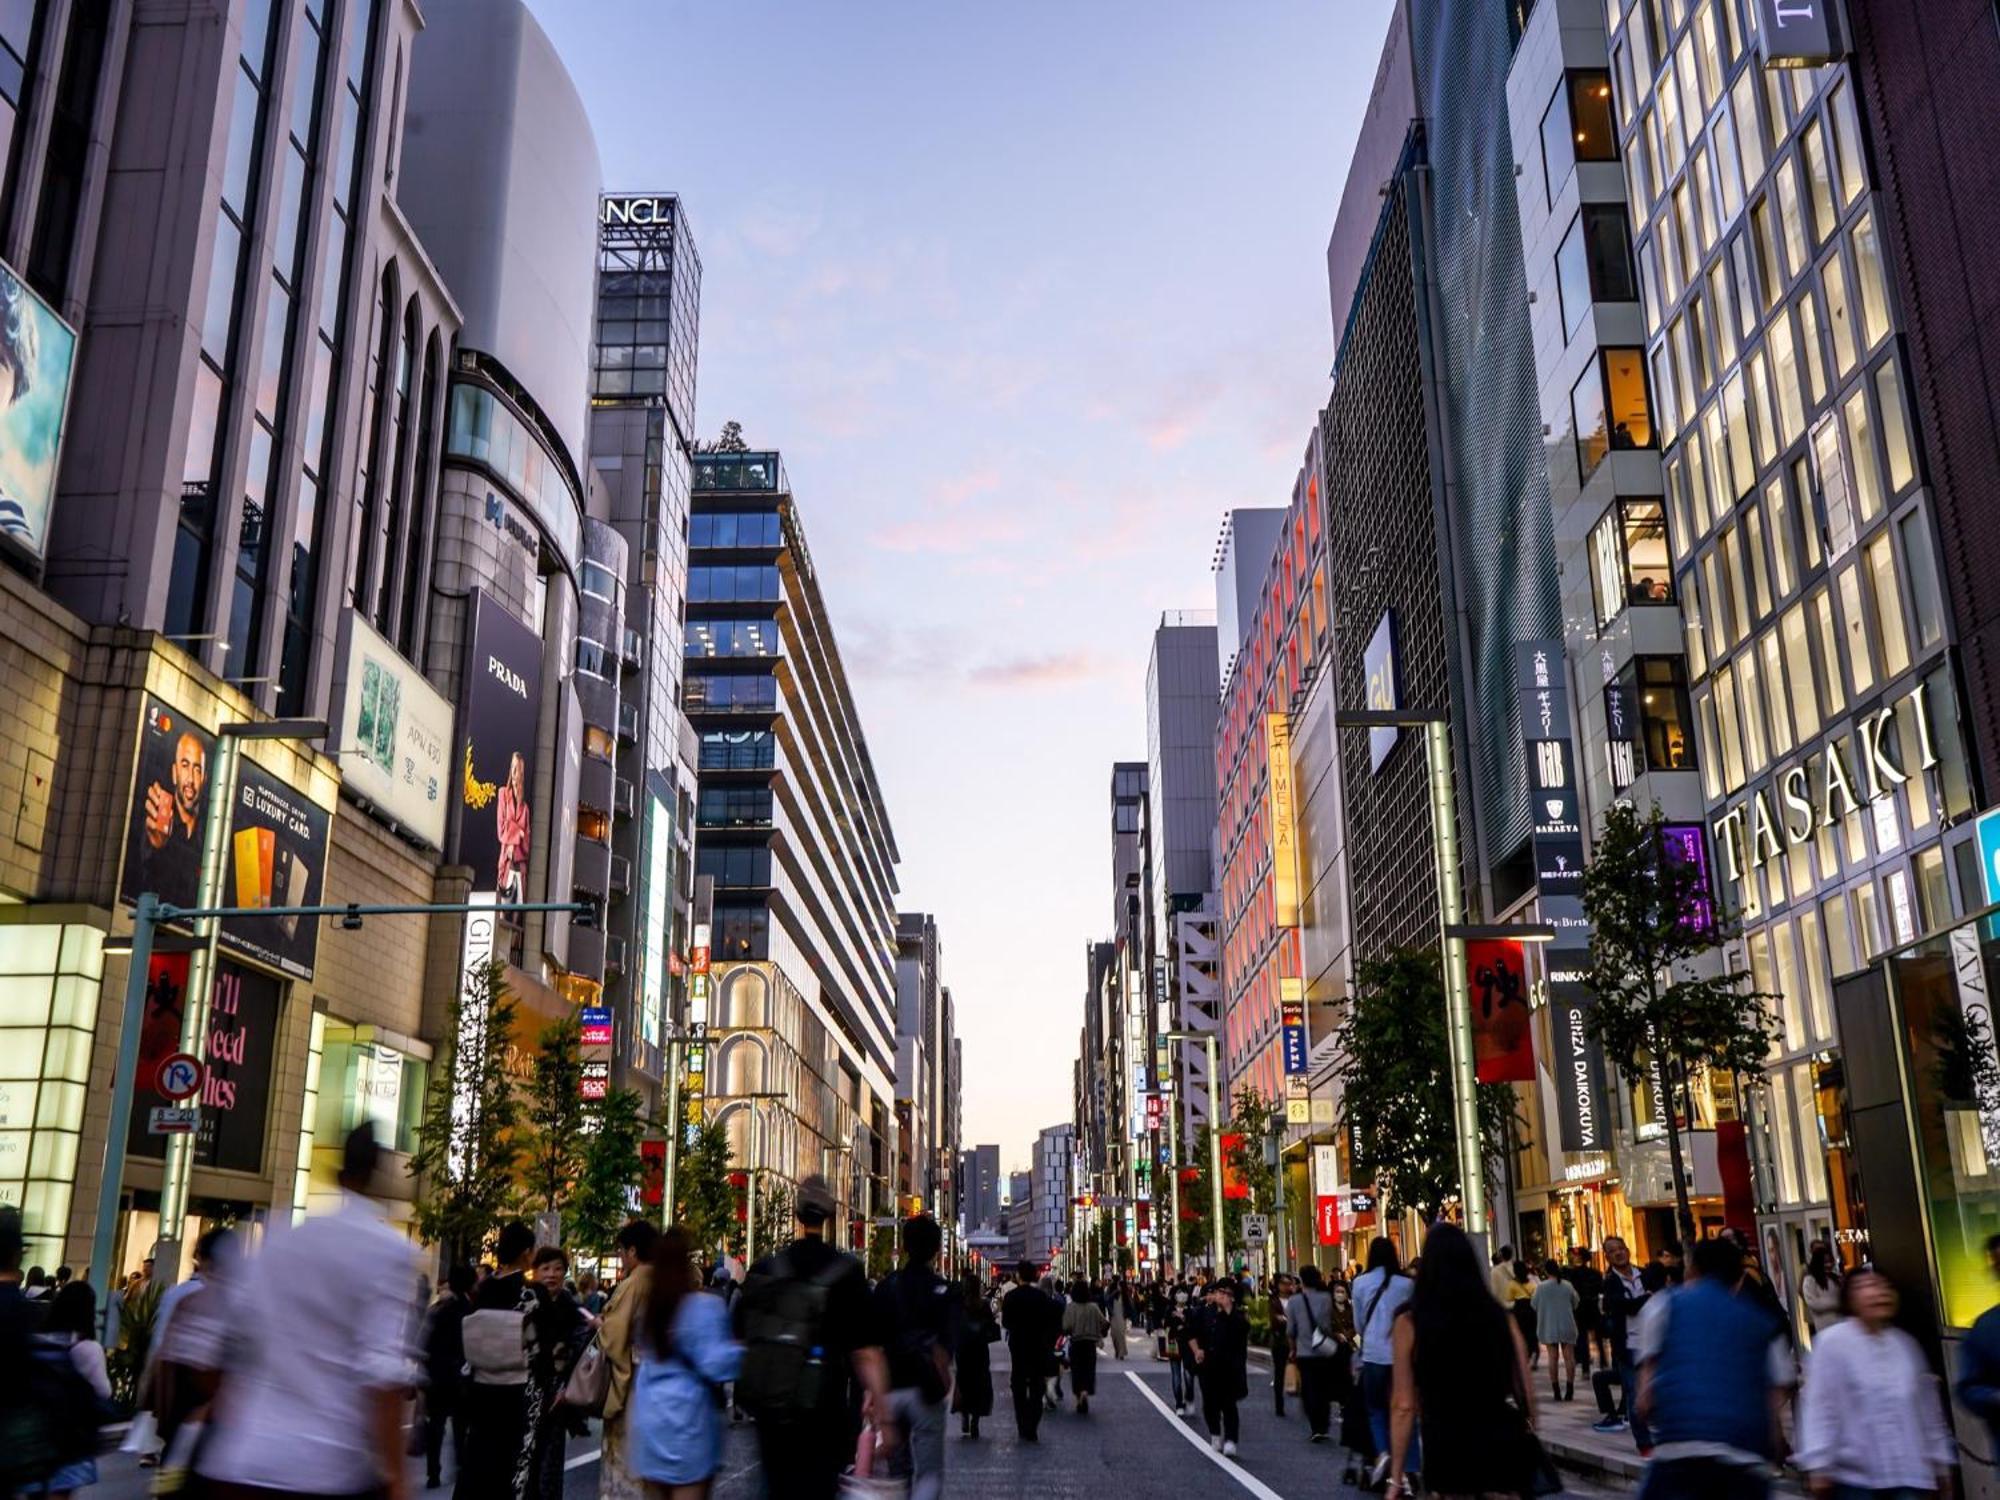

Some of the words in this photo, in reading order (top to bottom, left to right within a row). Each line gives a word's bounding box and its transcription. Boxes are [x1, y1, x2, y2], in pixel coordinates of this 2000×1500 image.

[488, 655, 527, 699] PRADA
[1715, 684, 1938, 882] TASAKI
[256, 796, 287, 824] LUXURY
[1570, 1009, 1585, 1056] GINZA
[179, 1109, 195, 1121] 20
[1575, 1061, 1595, 1147] DAIKOKUYA
